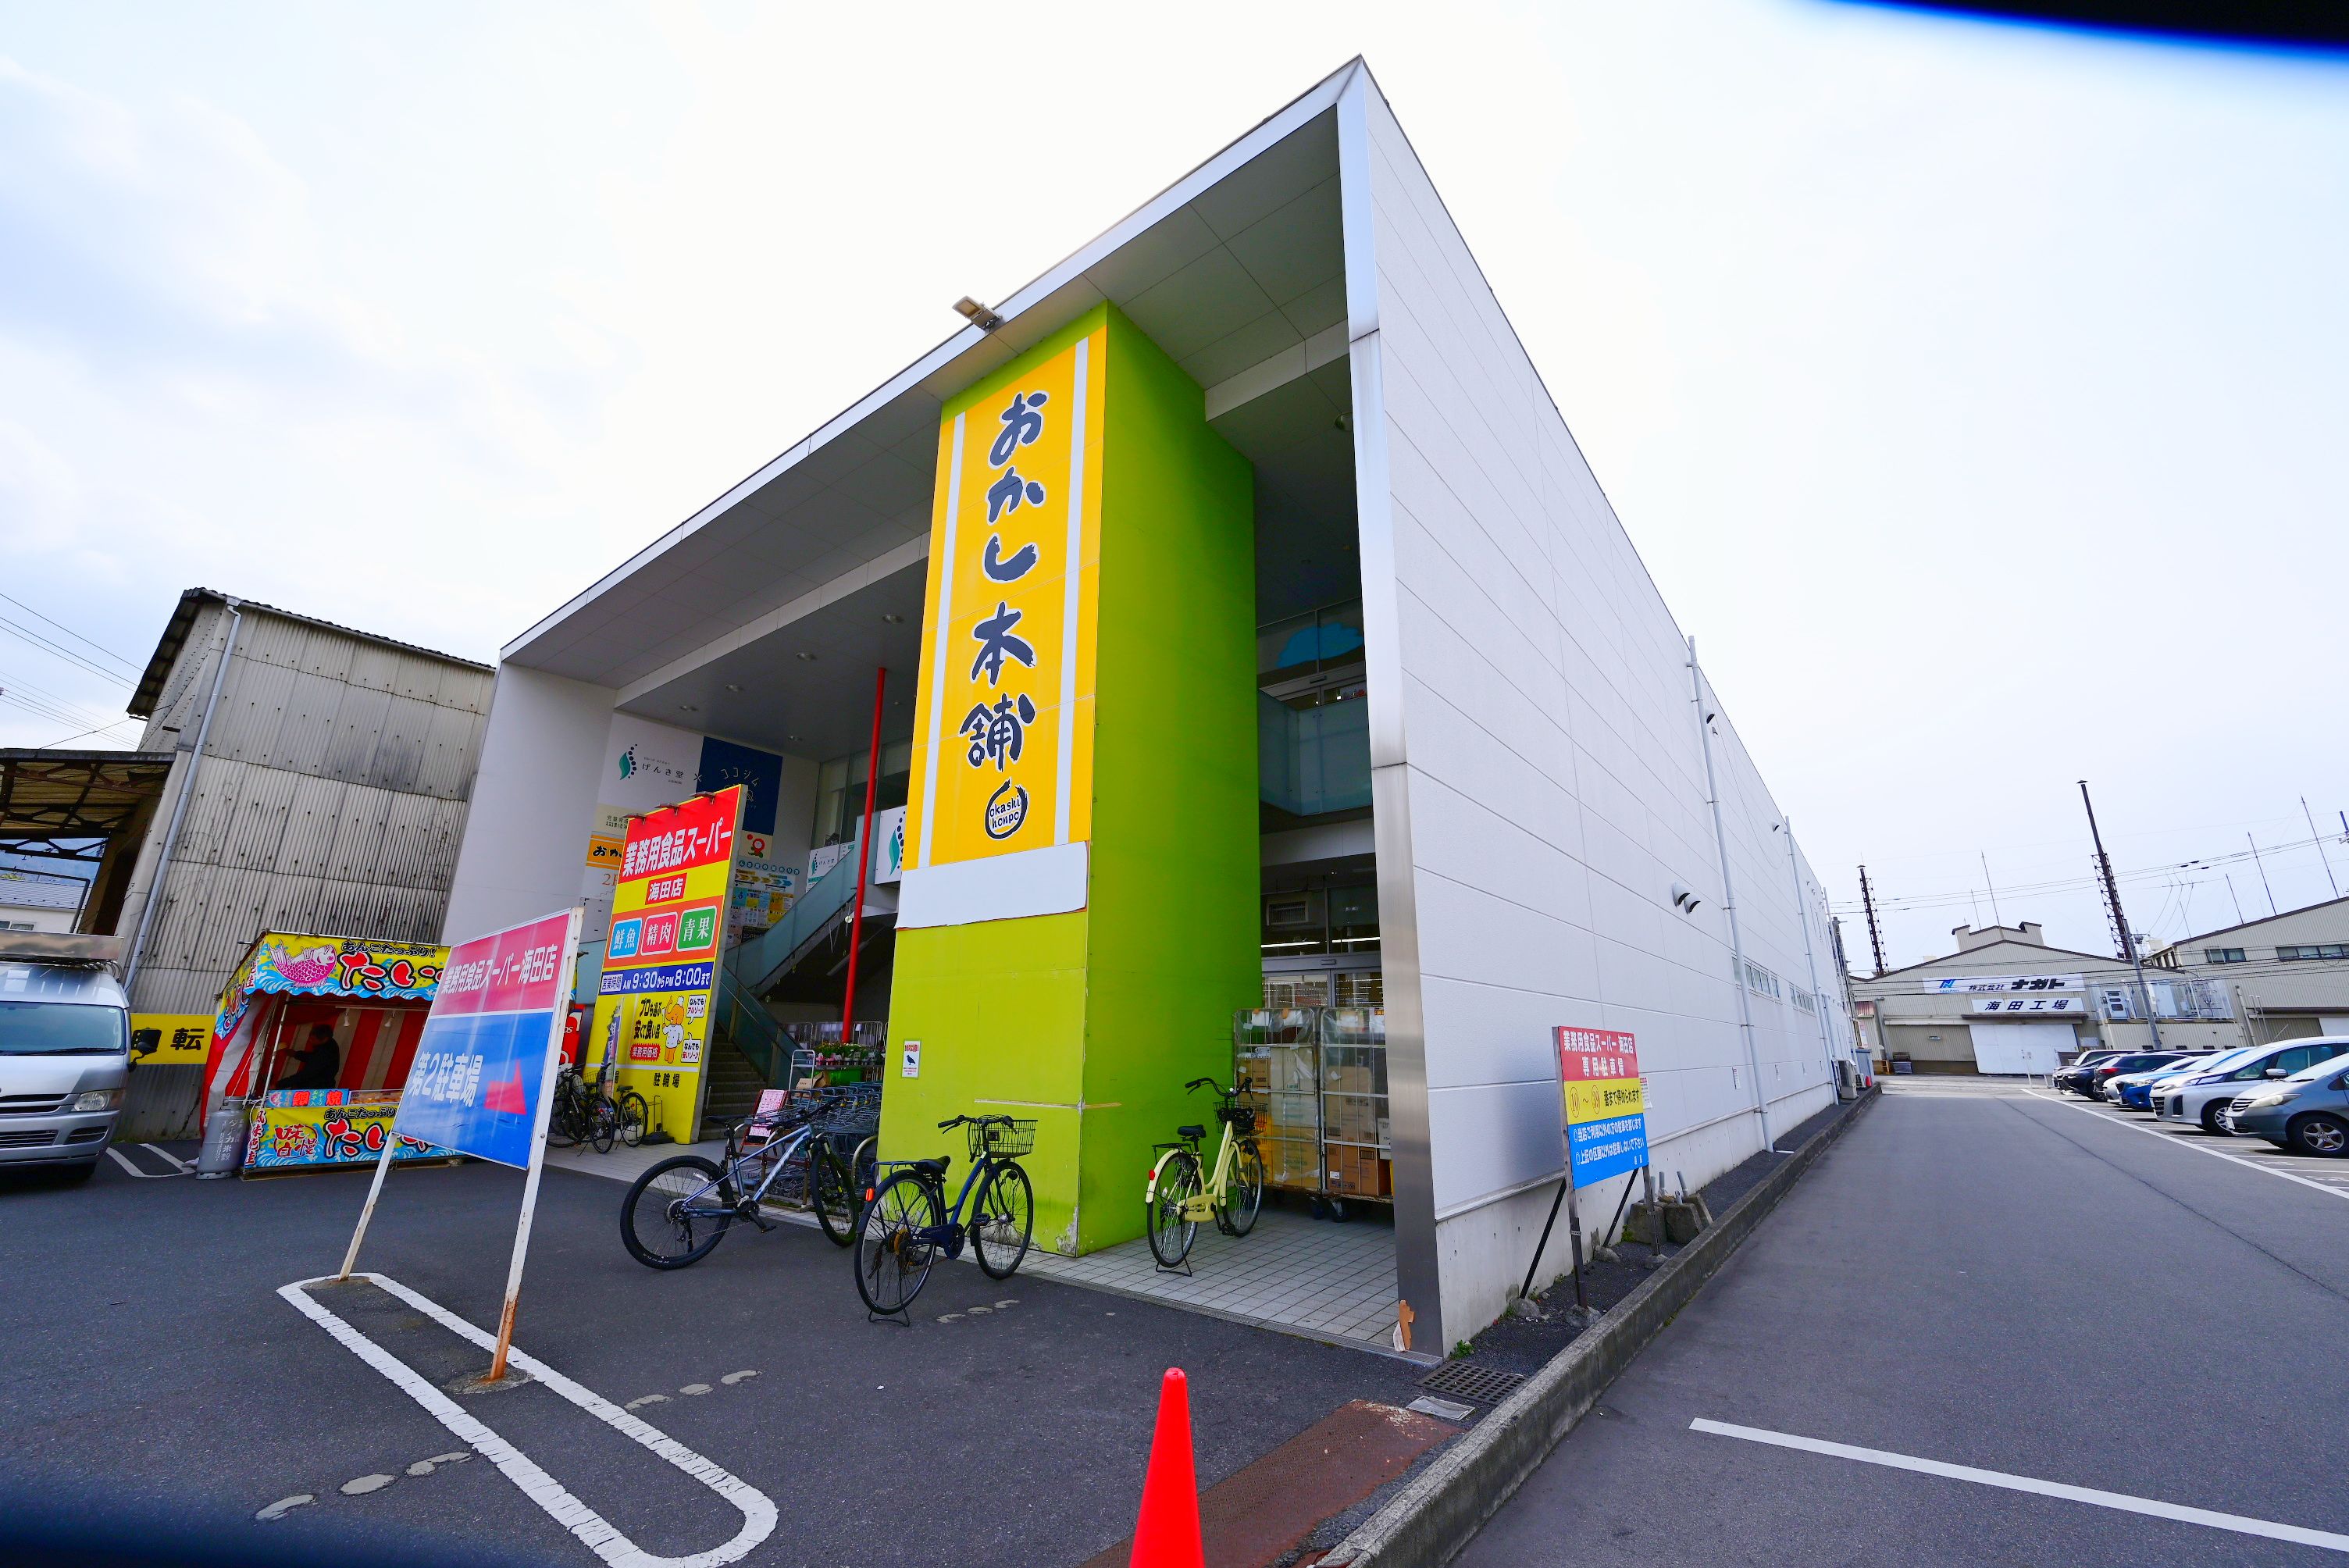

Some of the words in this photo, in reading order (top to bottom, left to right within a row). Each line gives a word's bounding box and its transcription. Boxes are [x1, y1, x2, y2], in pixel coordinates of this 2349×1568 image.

[959, 390, 1050, 773] おかし本舗
[642, 763, 684, 779] げんき堂
[721, 767, 760, 787] ココジム
[989, 796, 1021, 817] okashi
[992, 811, 1019, 829] honpo
[622, 817, 732, 877] 業務用食品スーパー
[648, 878, 683, 900] 海田店
[613, 928, 636, 950] 鮮魚
[647, 922, 672, 946] 精肉
[683, 916, 710, 942] 青果
[441, 944, 558, 995] 業務用食品スーパー海田店
[602, 976, 622, 990] 営業時間
[2010, 978, 2065, 990] ナガト
[640, 997, 663, 1017] プロも選ぶ
[1984, 1000, 2069, 1010] 海田工場
[633, 1019, 661, 1040] 安くて良い品
[684, 1042, 700, 1050] なんでも
[1563, 1030, 1616, 1053] 業務用食品スーパー
[1618, 1035, 1634, 1054] 海田店
[1582, 1056, 1624, 1077] 専用駐車場
[408, 1051, 483, 1107] 第2駐車場
[653, 1072, 680, 1089] 駐輪場
